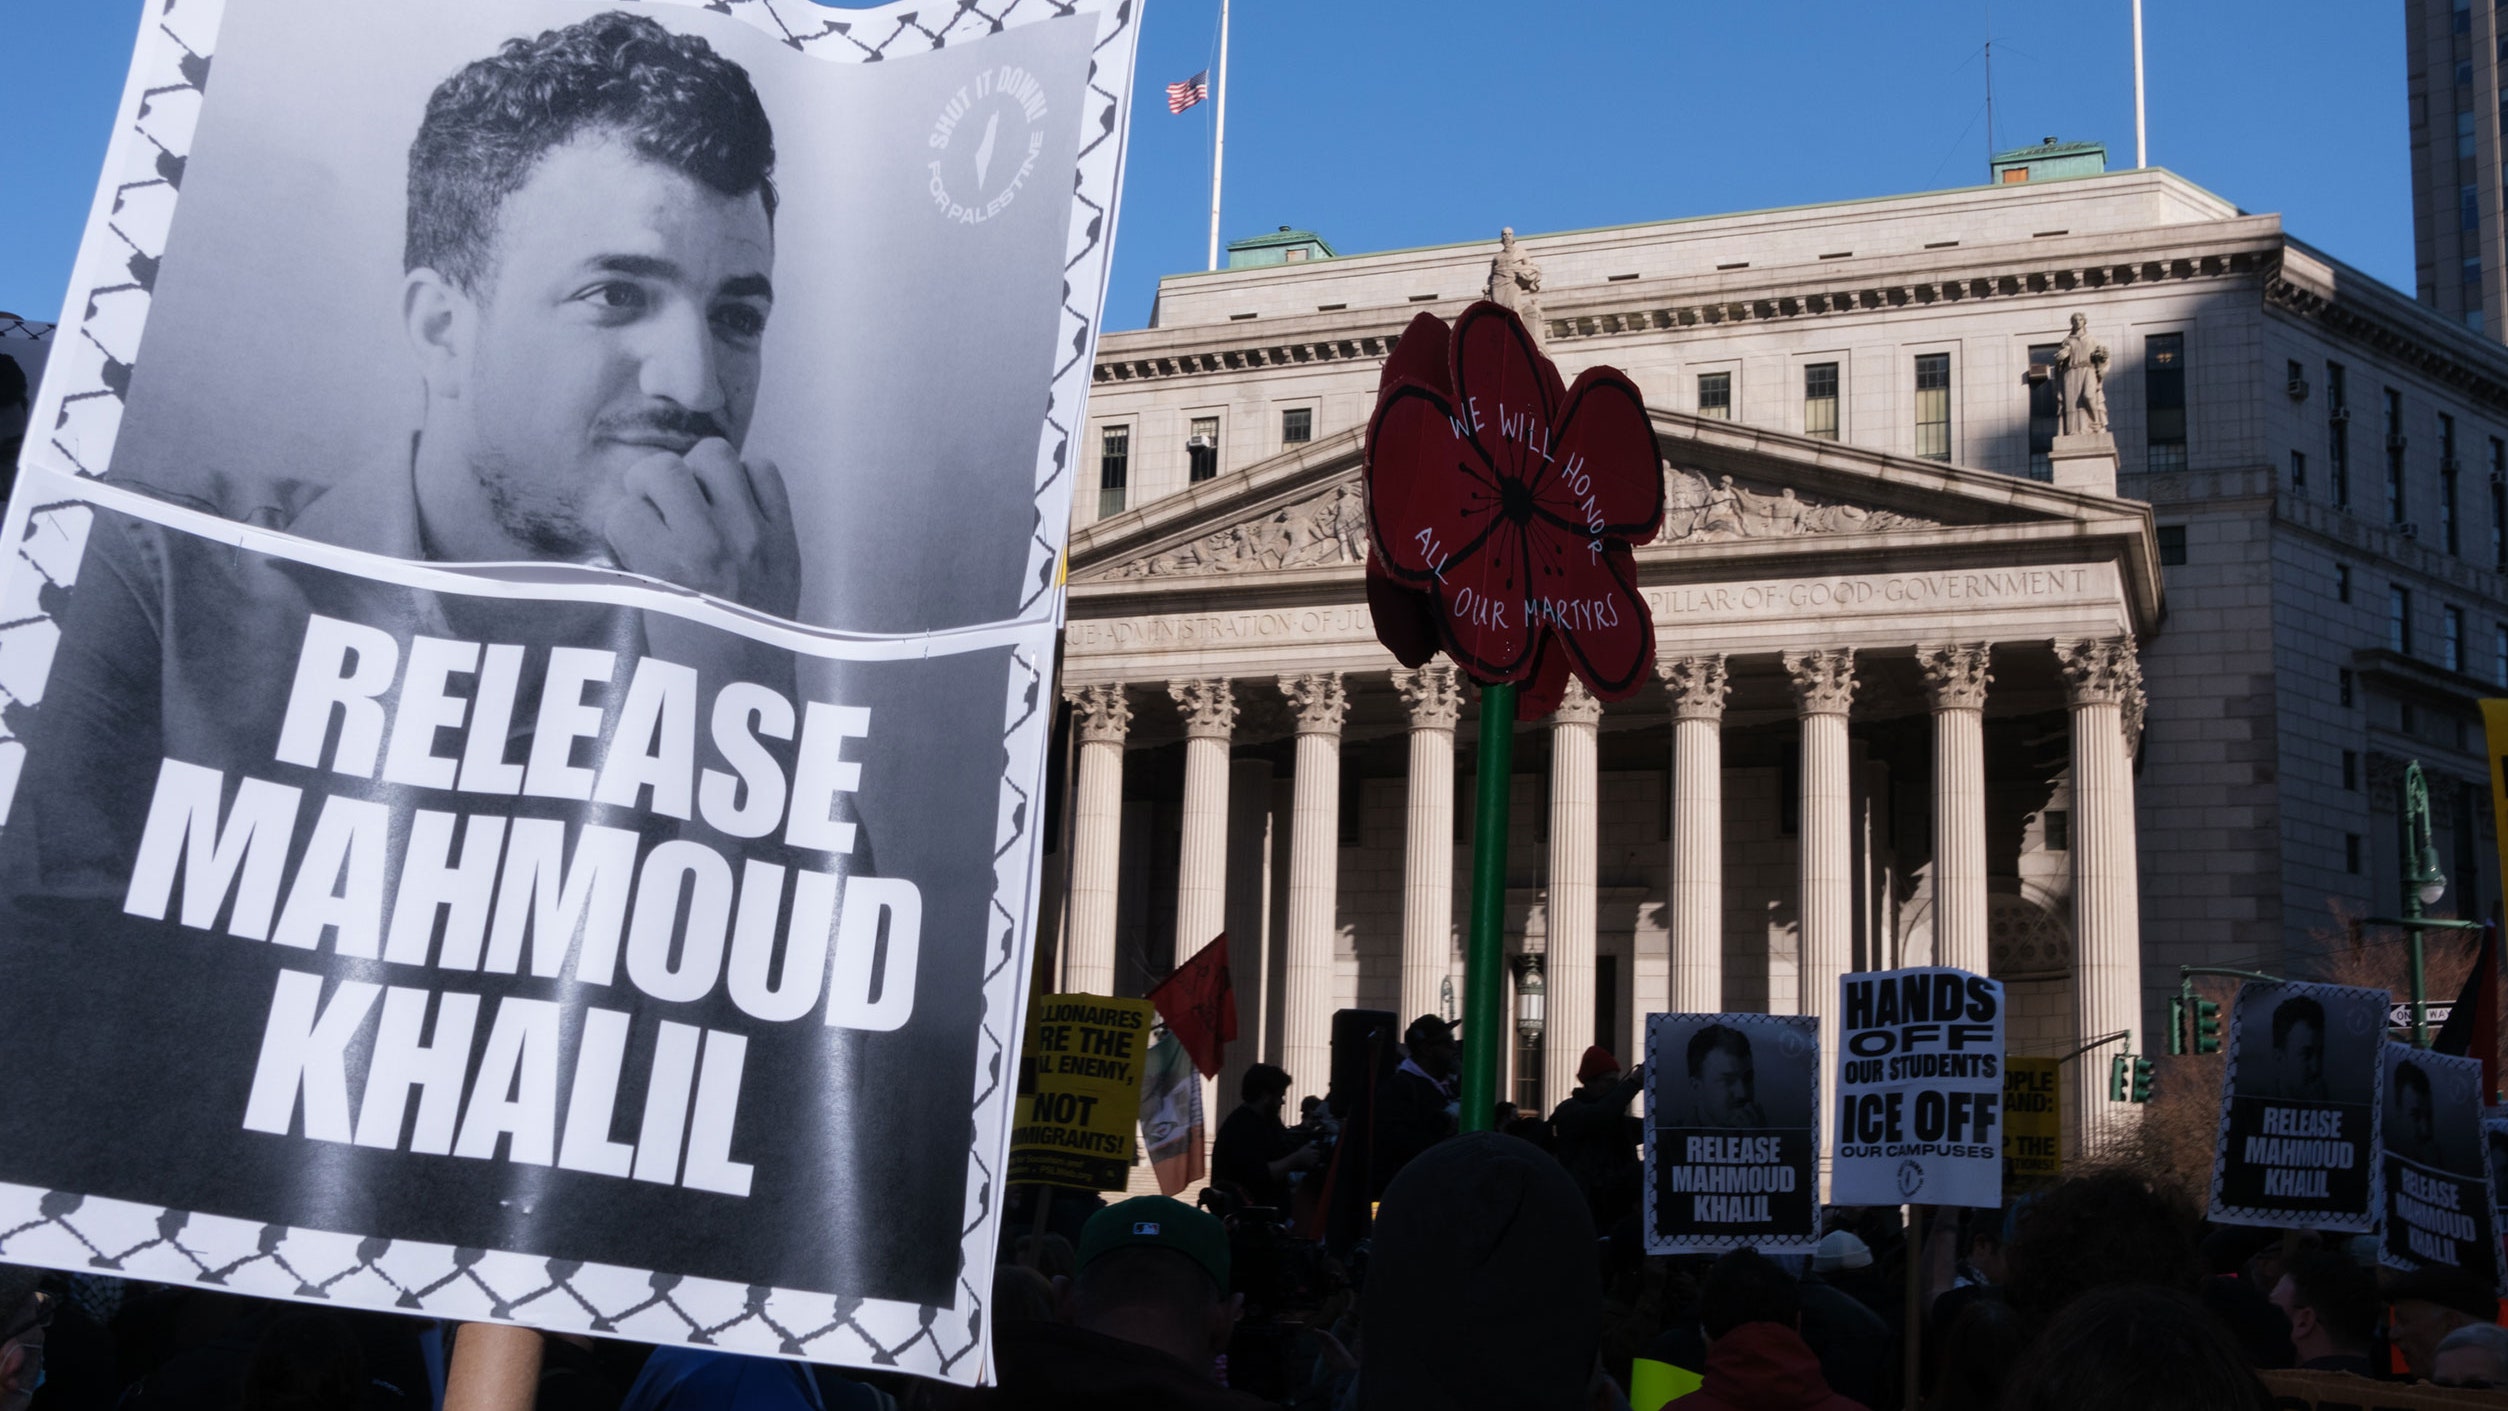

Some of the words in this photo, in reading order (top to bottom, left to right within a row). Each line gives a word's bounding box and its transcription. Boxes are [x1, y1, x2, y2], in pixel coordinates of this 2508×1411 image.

[928, 85, 971, 149] SHUT
[976, 68, 993, 100] IT
[996, 65, 1048, 124] DOWN!
[928, 160, 951, 213] FOR
[947, 130, 1044, 225] PALESTINE
[1450, 396, 1486, 440] WE
[1500, 402, 1555, 463] WILL
[1561, 451, 1605, 566] HONOR
[1415, 527, 1448, 585] ALL
[1454, 587, 1509, 632] OUR
[1524, 593, 1618, 632] MARTYRS
[1651, 588, 1733, 614] PILLAR
[1742, 585, 1777, 609] OF
[1789, 581, 1873, 606] GOOD
[1885, 568, 2086, 601] GOVERNMENT
[1106, 613, 1292, 644] ADMINISTRATION
[1302, 611, 1333, 633] OF
[1338, 608, 1376, 631] JU
[275, 613, 871, 854] RELEASE
[123, 757, 922, 1032] MAHMOUD
[1847, 974, 1996, 1030] HANDS
[1079, 1027, 1134, 1058] THE
[1849, 1024, 1994, 1057] OFF
[243, 968, 754, 1197] KHALIL
[1058, 1055, 1134, 1086] ENEMY,
[1845, 1059, 1884, 1084] OUR
[1889, 1053, 1997, 1080] STUDENTS
[1031, 1092, 1098, 1126] NOT
[1842, 1092, 1904, 1144] ICE
[1915, 1090, 1998, 1143] OFF
[2262, 1106, 2343, 1138] RELEASE
[1686, 1136, 1782, 1164] RELEASE
[1841, 1145, 1883, 1158] OUR
[1886, 1144, 1994, 1159] CAMPUSES
[2016, 1136, 2055, 1156] THE
[2244, 1135, 2355, 1169] MAHMOUD
[1672, 1165, 1796, 1193] MAHMOUD
[2264, 1167, 2330, 1198] KHALIL
[1693, 1195, 1773, 1223] KHALIL
